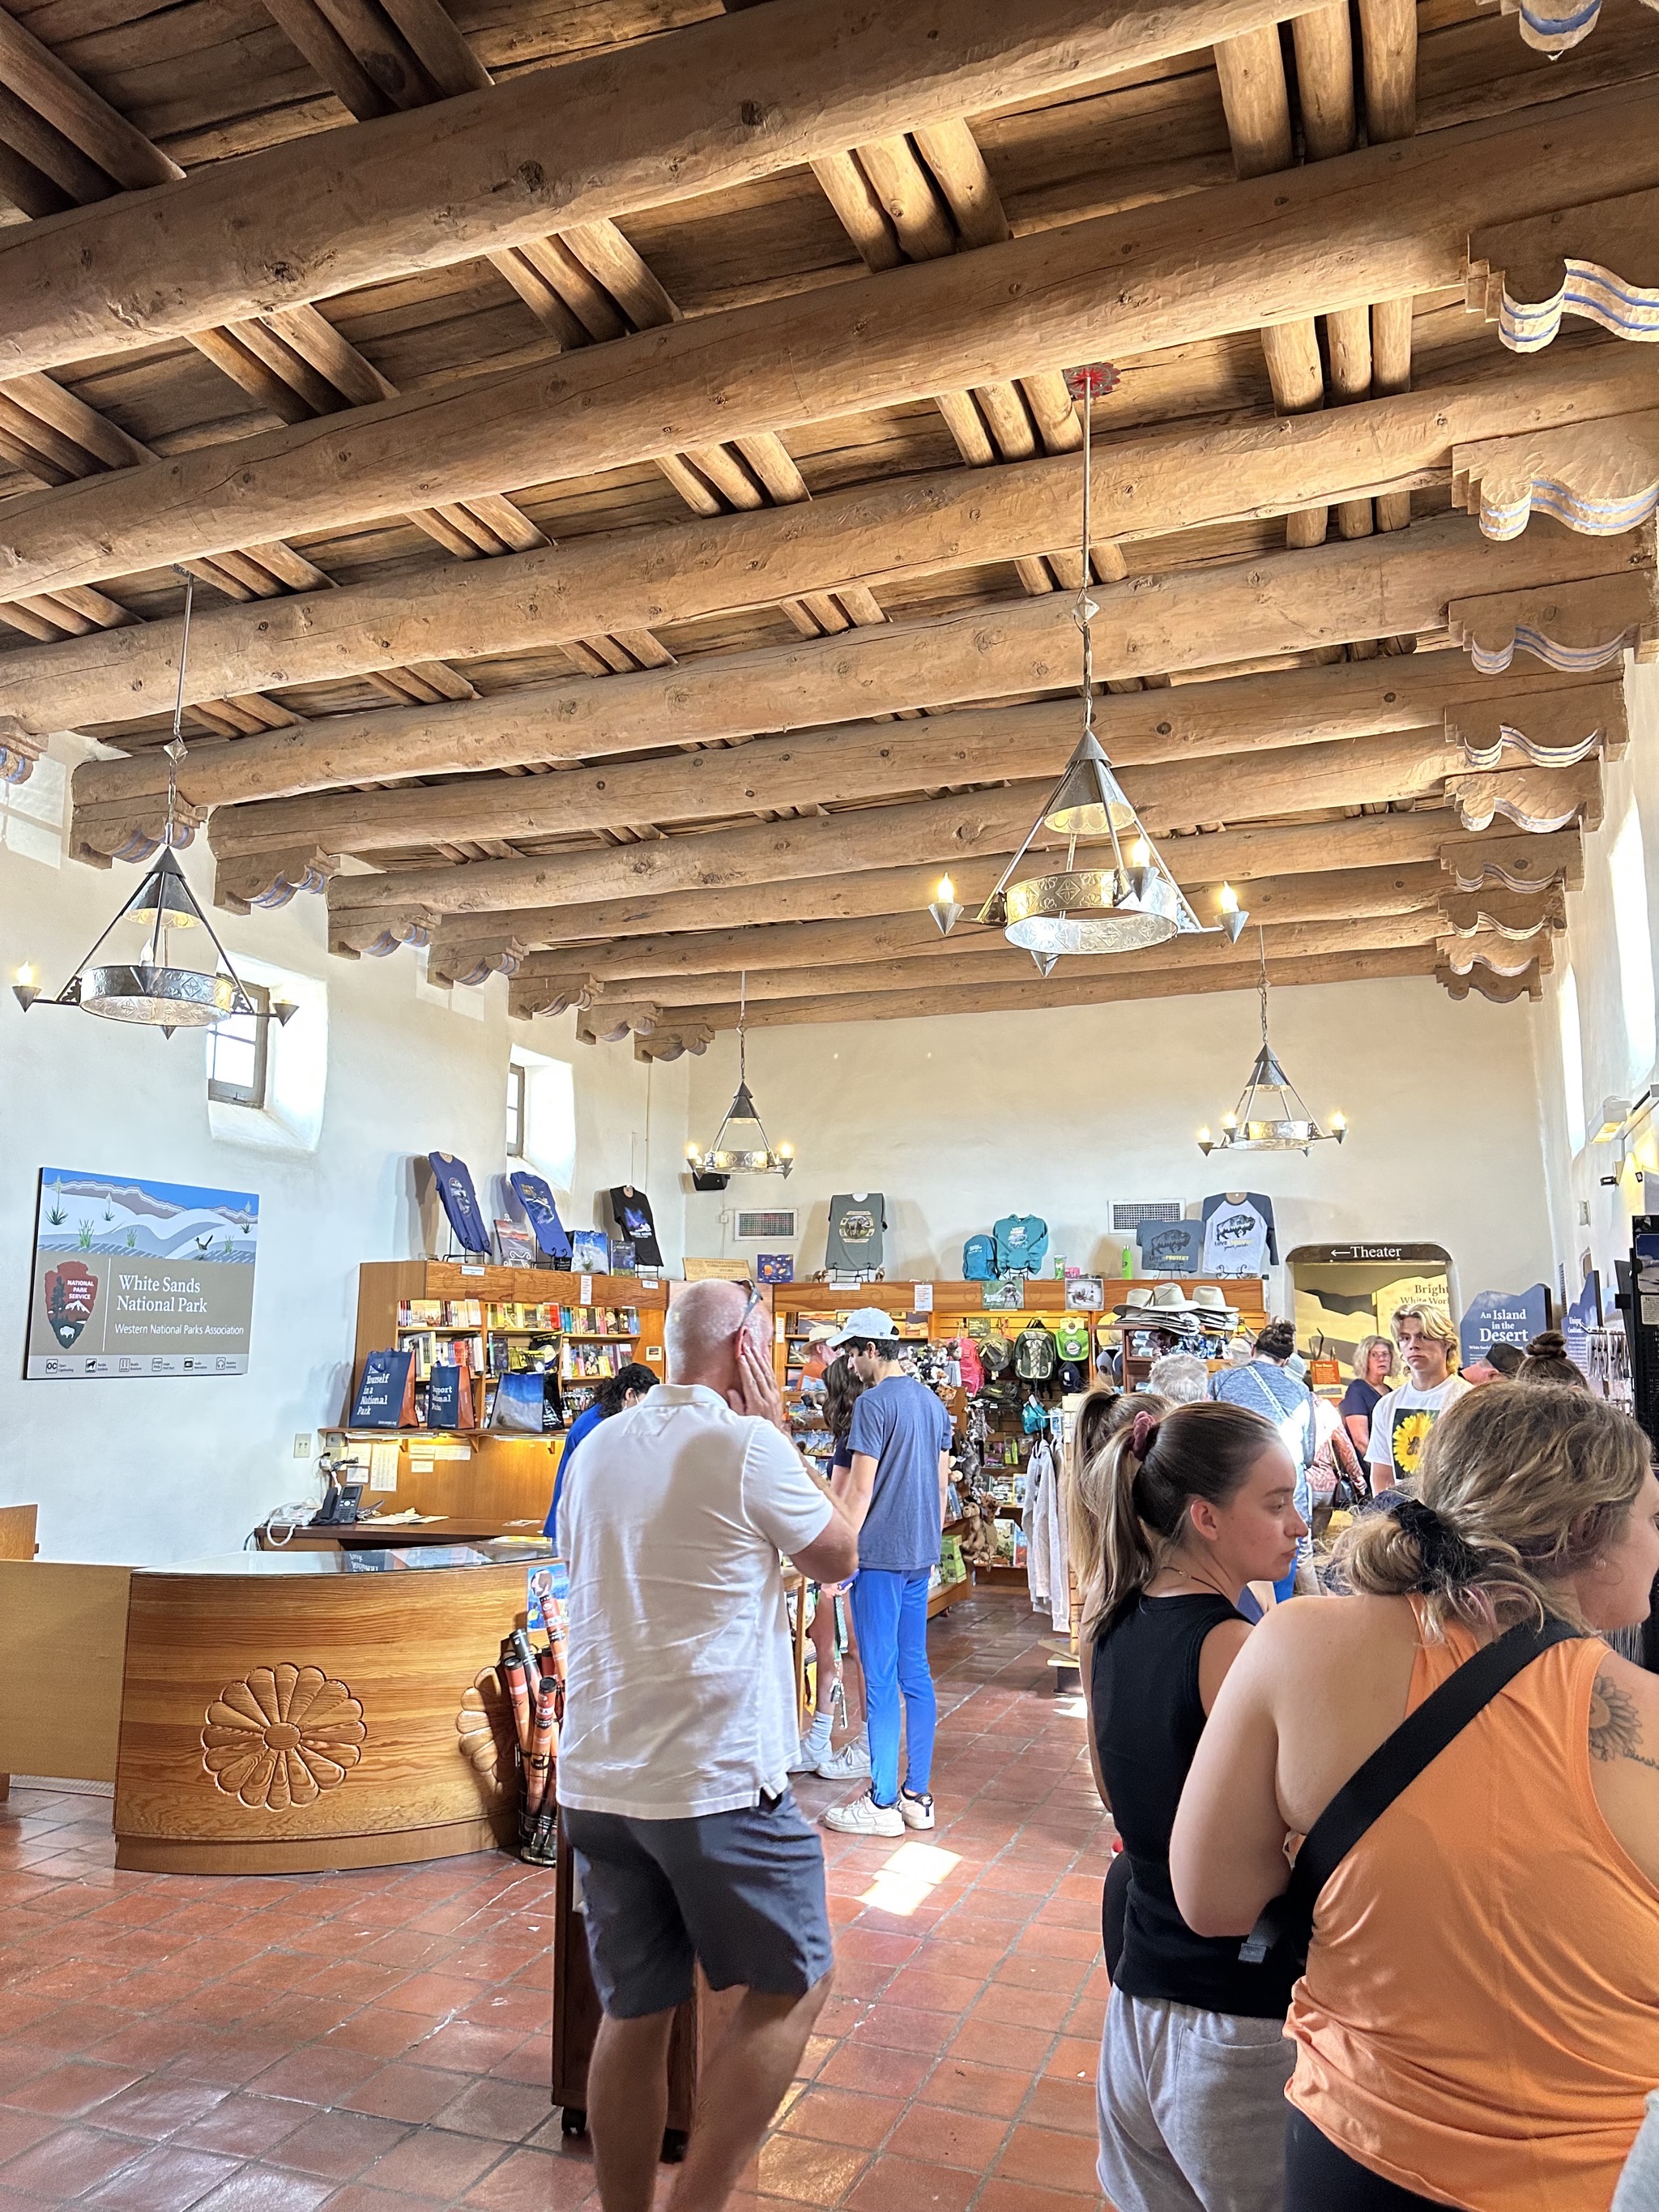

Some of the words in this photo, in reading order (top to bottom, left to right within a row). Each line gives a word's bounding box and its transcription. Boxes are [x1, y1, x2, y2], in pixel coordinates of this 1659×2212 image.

[1350, 1246, 1402, 1258] Theater
[118, 1275, 160, 1292] White
[162, 1276, 201, 1293] Sands
[117, 1296, 175, 1312] National
[177, 1297, 207, 1313] Park
[1480, 1311, 1491, 1319] An
[1493, 1309, 1527, 1320] Island
[115, 1323, 148, 1334] Western
[150, 1324, 182, 1334] National
[184, 1324, 203, 1334] Parks
[204, 1325, 244, 1335] Association
[1491, 1321, 1500, 1330] in
[1502, 1321, 1515, 1330] the
[1479, 1328, 1529, 1342] Desert
[47, 1362, 58, 1370] OC
[366, 1373, 390, 1385] Yourself
[362, 1386, 369, 1395] in
[360, 1394, 388, 1405] National
[356, 1405, 372, 1416] Park
